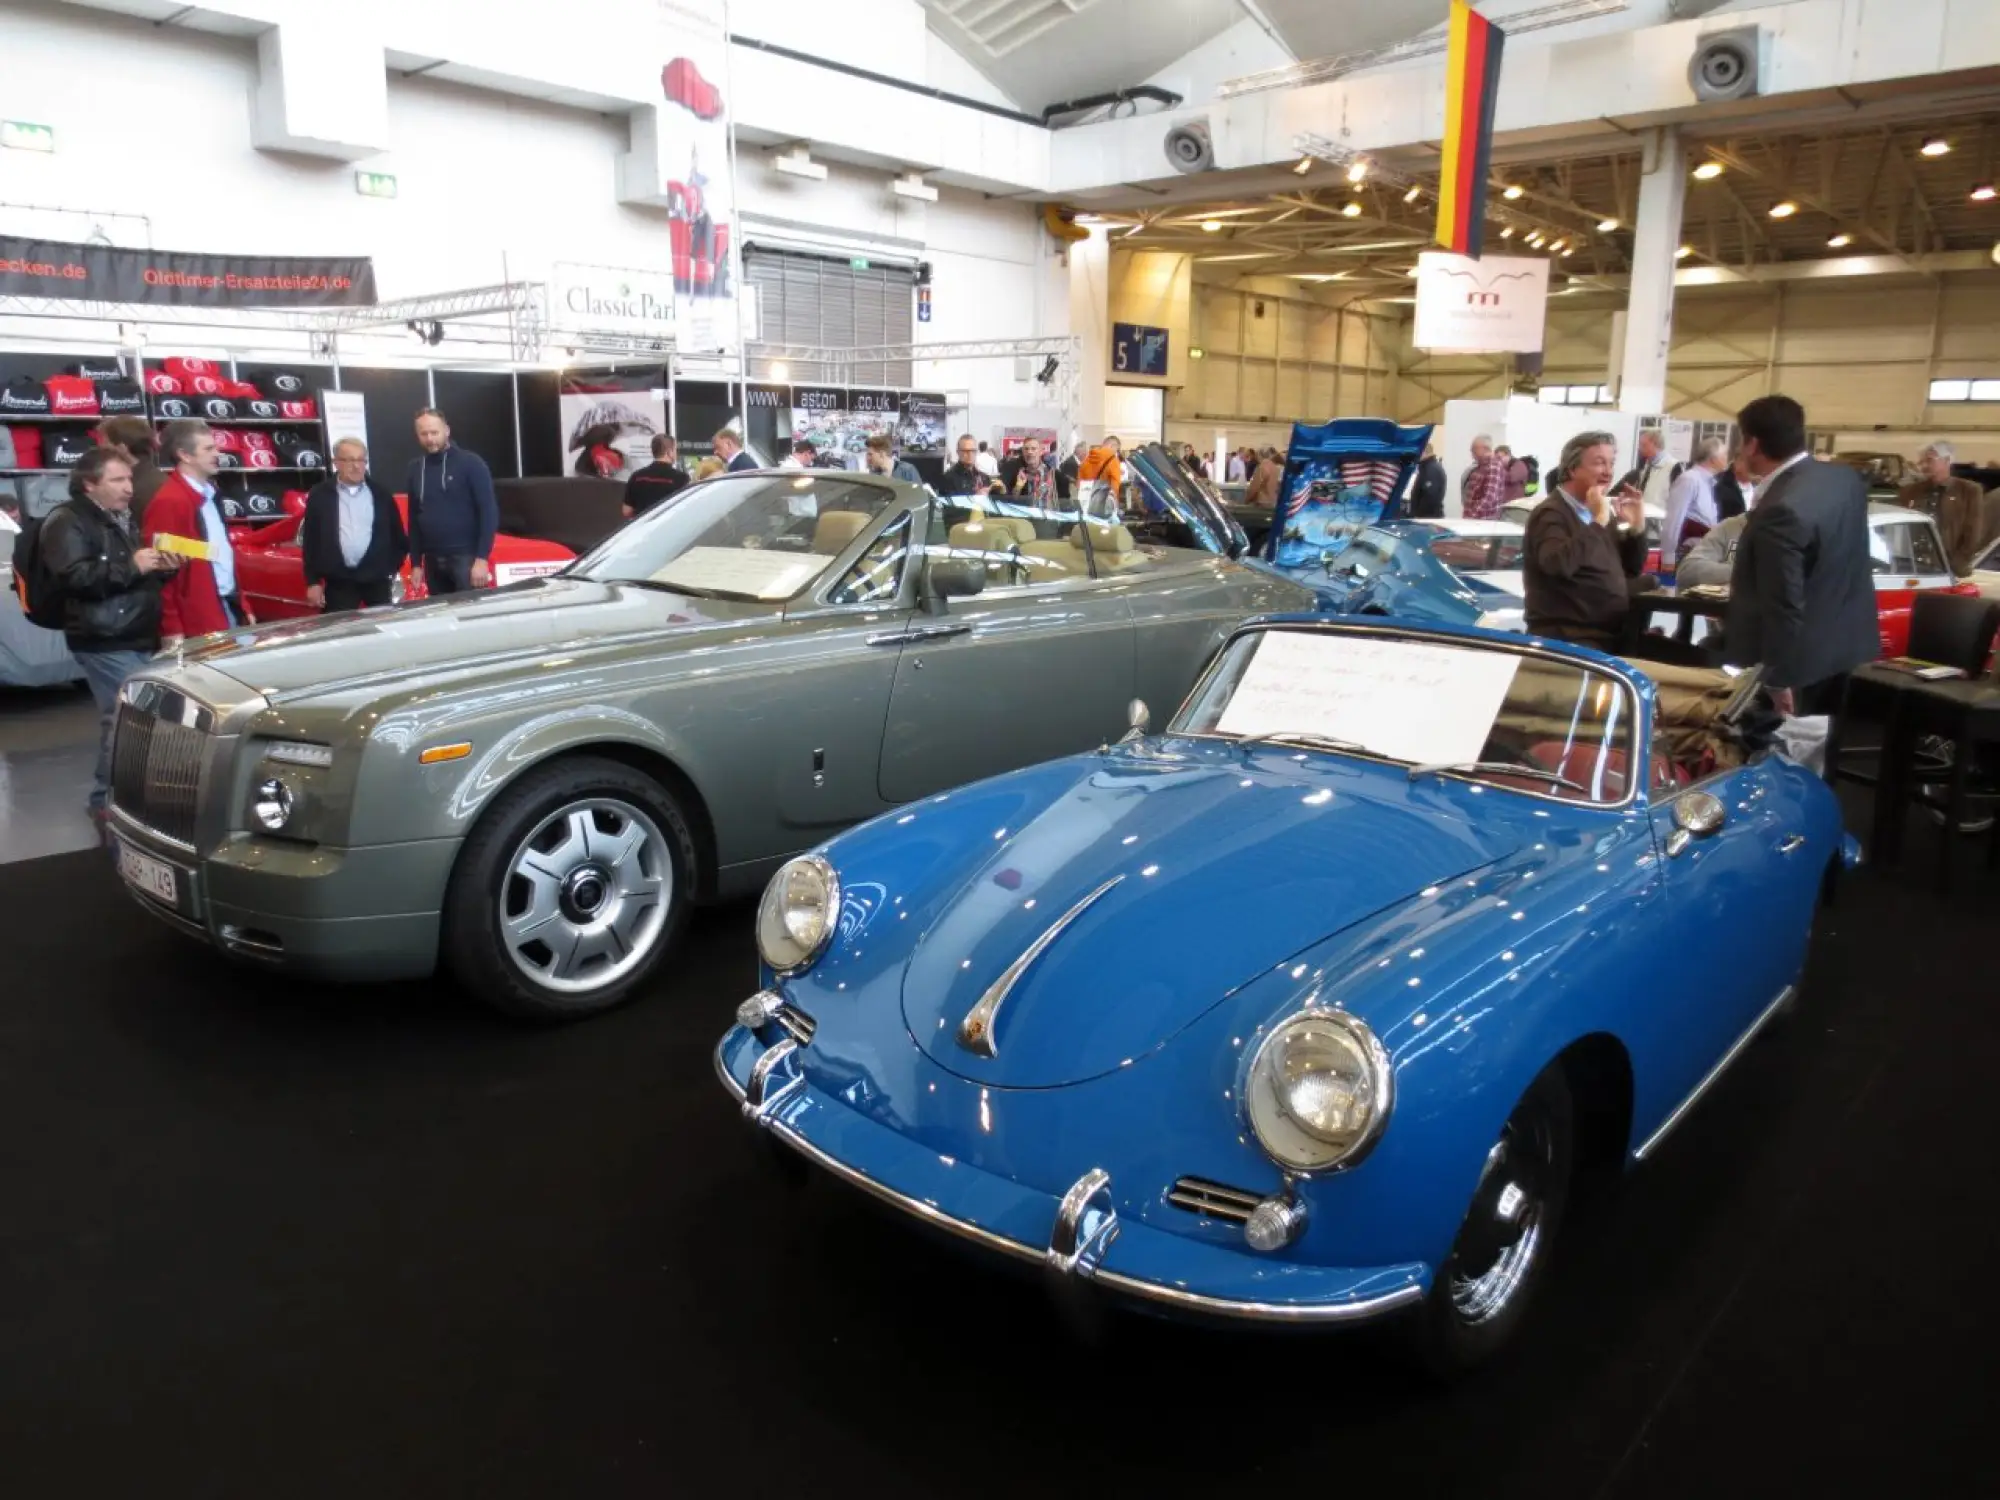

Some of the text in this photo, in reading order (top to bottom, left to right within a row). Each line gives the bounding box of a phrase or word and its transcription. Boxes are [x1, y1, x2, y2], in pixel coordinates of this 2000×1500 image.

[1116, 341, 1128, 370] 5
[747, 391, 784, 407] www.
[800, 390, 837, 409] aston
[854, 391, 890, 411] .co.uk
